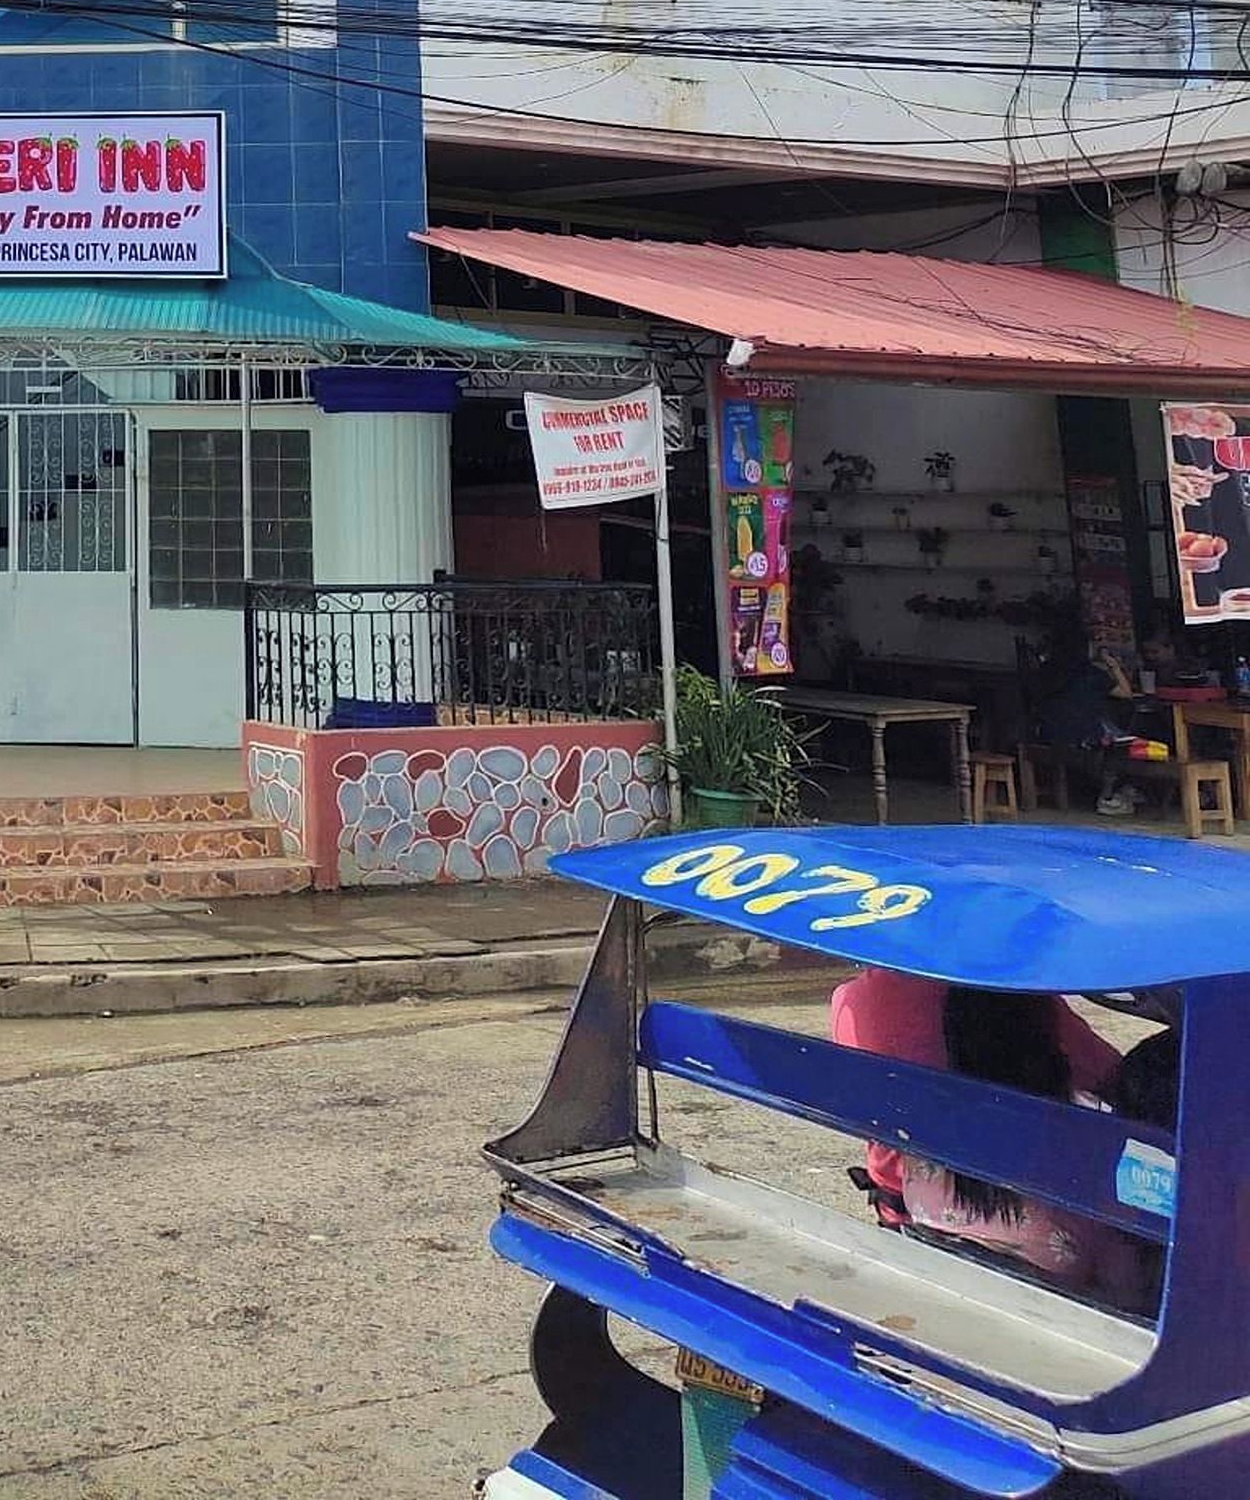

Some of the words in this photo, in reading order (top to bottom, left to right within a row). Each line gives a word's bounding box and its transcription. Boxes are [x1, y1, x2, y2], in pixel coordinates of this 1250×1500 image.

[97, 136, 205, 192] INN
[23, 205, 92, 229] From
[74, 243, 113, 264] CITY,
[118, 243, 197, 262] PALAWAN
[609, 402, 649, 423] SPACE
[574, 434, 592, 453] FOR
[595, 431, 624, 450] RENT
[641, 845, 932, 931] 0079
